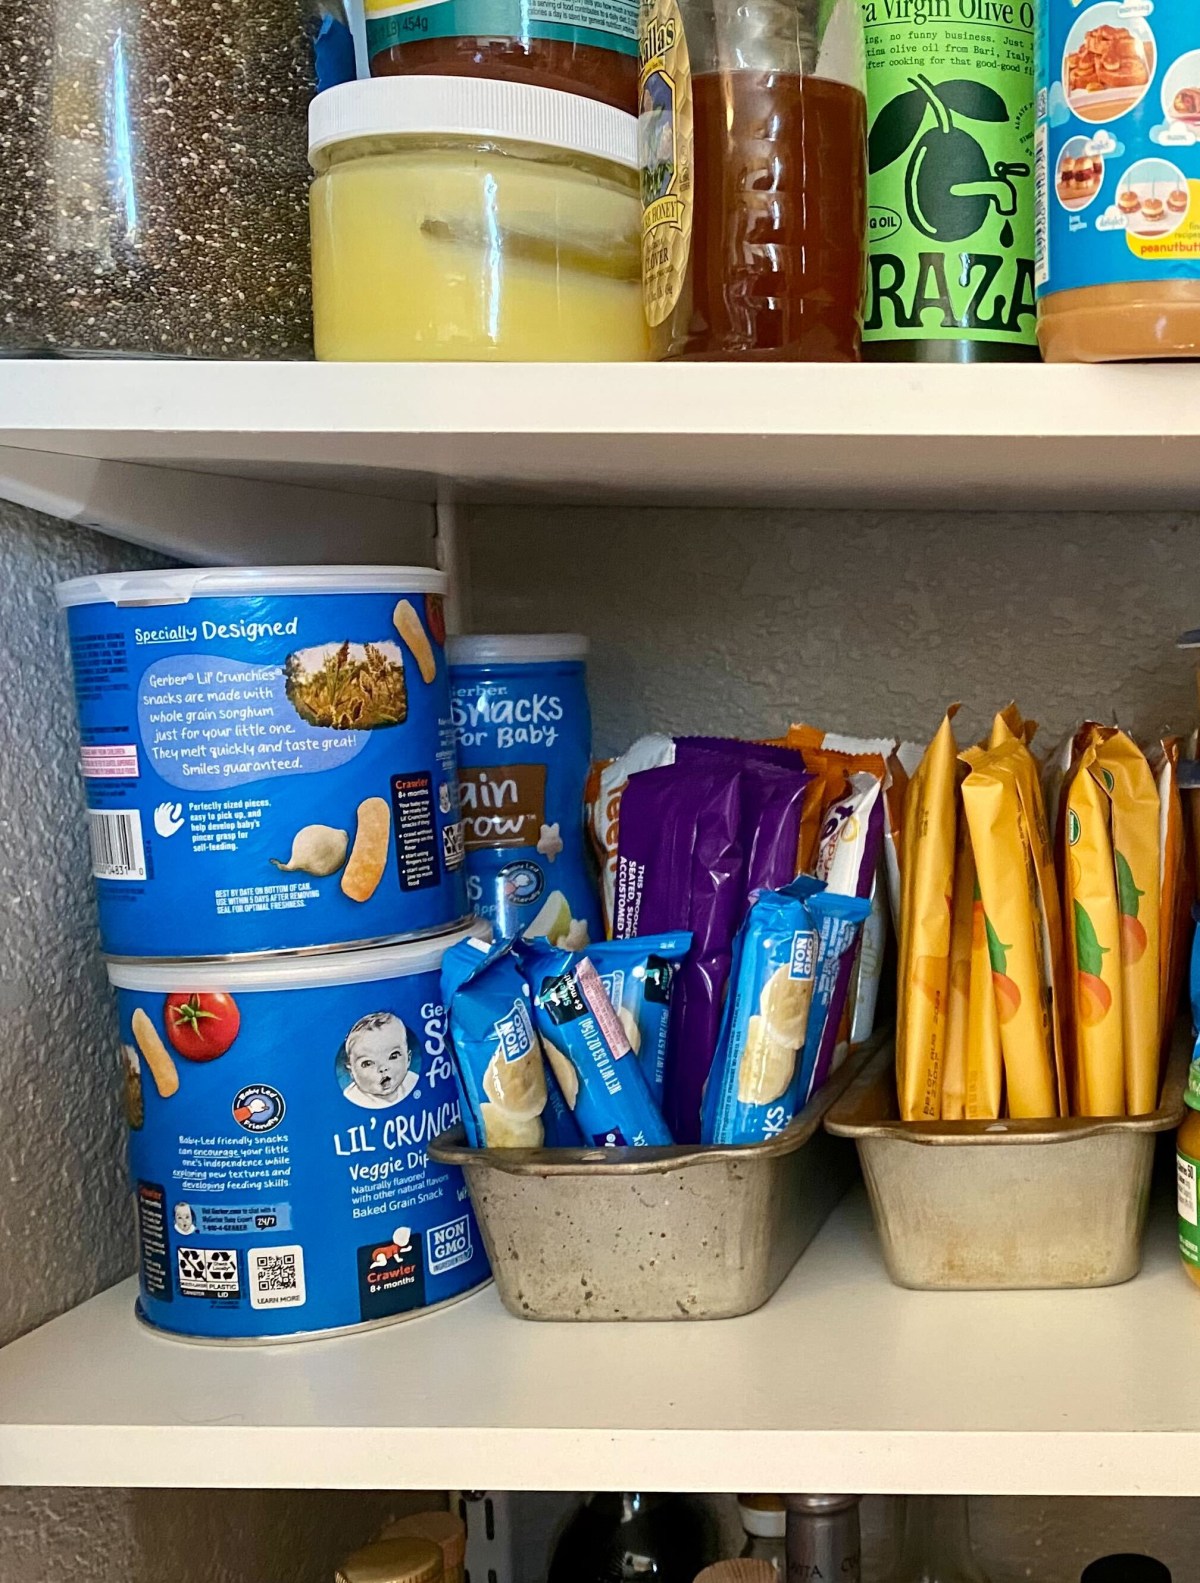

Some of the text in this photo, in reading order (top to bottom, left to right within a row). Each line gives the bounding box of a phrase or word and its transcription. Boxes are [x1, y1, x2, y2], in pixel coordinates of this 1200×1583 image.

[885, 0, 1014, 25] Virgin Olive
[403, 16, 429, 32] 454g
[890, 44, 968, 54] olive oil from
[908, 31, 1024, 48] funny business. Just
[889, 56, 971, 66] cooking for that
[879, 215, 897, 228] OIL
[135, 616, 298, 644] Specially Designed
[144, 687, 274, 706] snacks are made with
[150, 706, 274, 725] whole grain sorghum
[450, 694, 563, 728] Snacks
[154, 729, 178, 744] just
[181, 727, 200, 739] for
[202, 726, 230, 742] your
[235, 723, 266, 736] little
[497, 724, 558, 748] Baby
[152, 746, 184, 762] They
[181, 744, 206, 758] melt
[210, 742, 255, 760] quickly
[258, 740, 282, 752] and
[286, 736, 319, 751] taste
[322, 735, 357, 750] great!
[182, 757, 302, 776] Smiles guaranteed.
[616, 856, 628, 924] ACCUSTOMED
[793, 937, 808, 974] NON
[499, 1021, 519, 1057] NON
[514, 1014, 528, 1050] GMO
[217, 1134, 288, 1147] friendly snacks
[334, 1117, 378, 1156] LIL'
[194, 1145, 290, 1158] encourage your little
[204, 1156, 290, 1168] independence while
[228, 1167, 292, 1179] textures and
[350, 1156, 404, 1182] Veggie
[182, 1180, 262, 1191] developing feeding
[351, 1170, 426, 1194] Naturally flavored
[352, 1172, 450, 1205] with other natural flavors
[353, 1188, 444, 1218] Baked Grain Snack
[257, 1216, 276, 1226] 24/7
[433, 1220, 465, 1245] NON
[434, 1237, 466, 1260] GMO
[367, 1263, 416, 1284] Crawler
[384, 1275, 415, 1291] months
[257, 1294, 300, 1304] LEARN MORE
